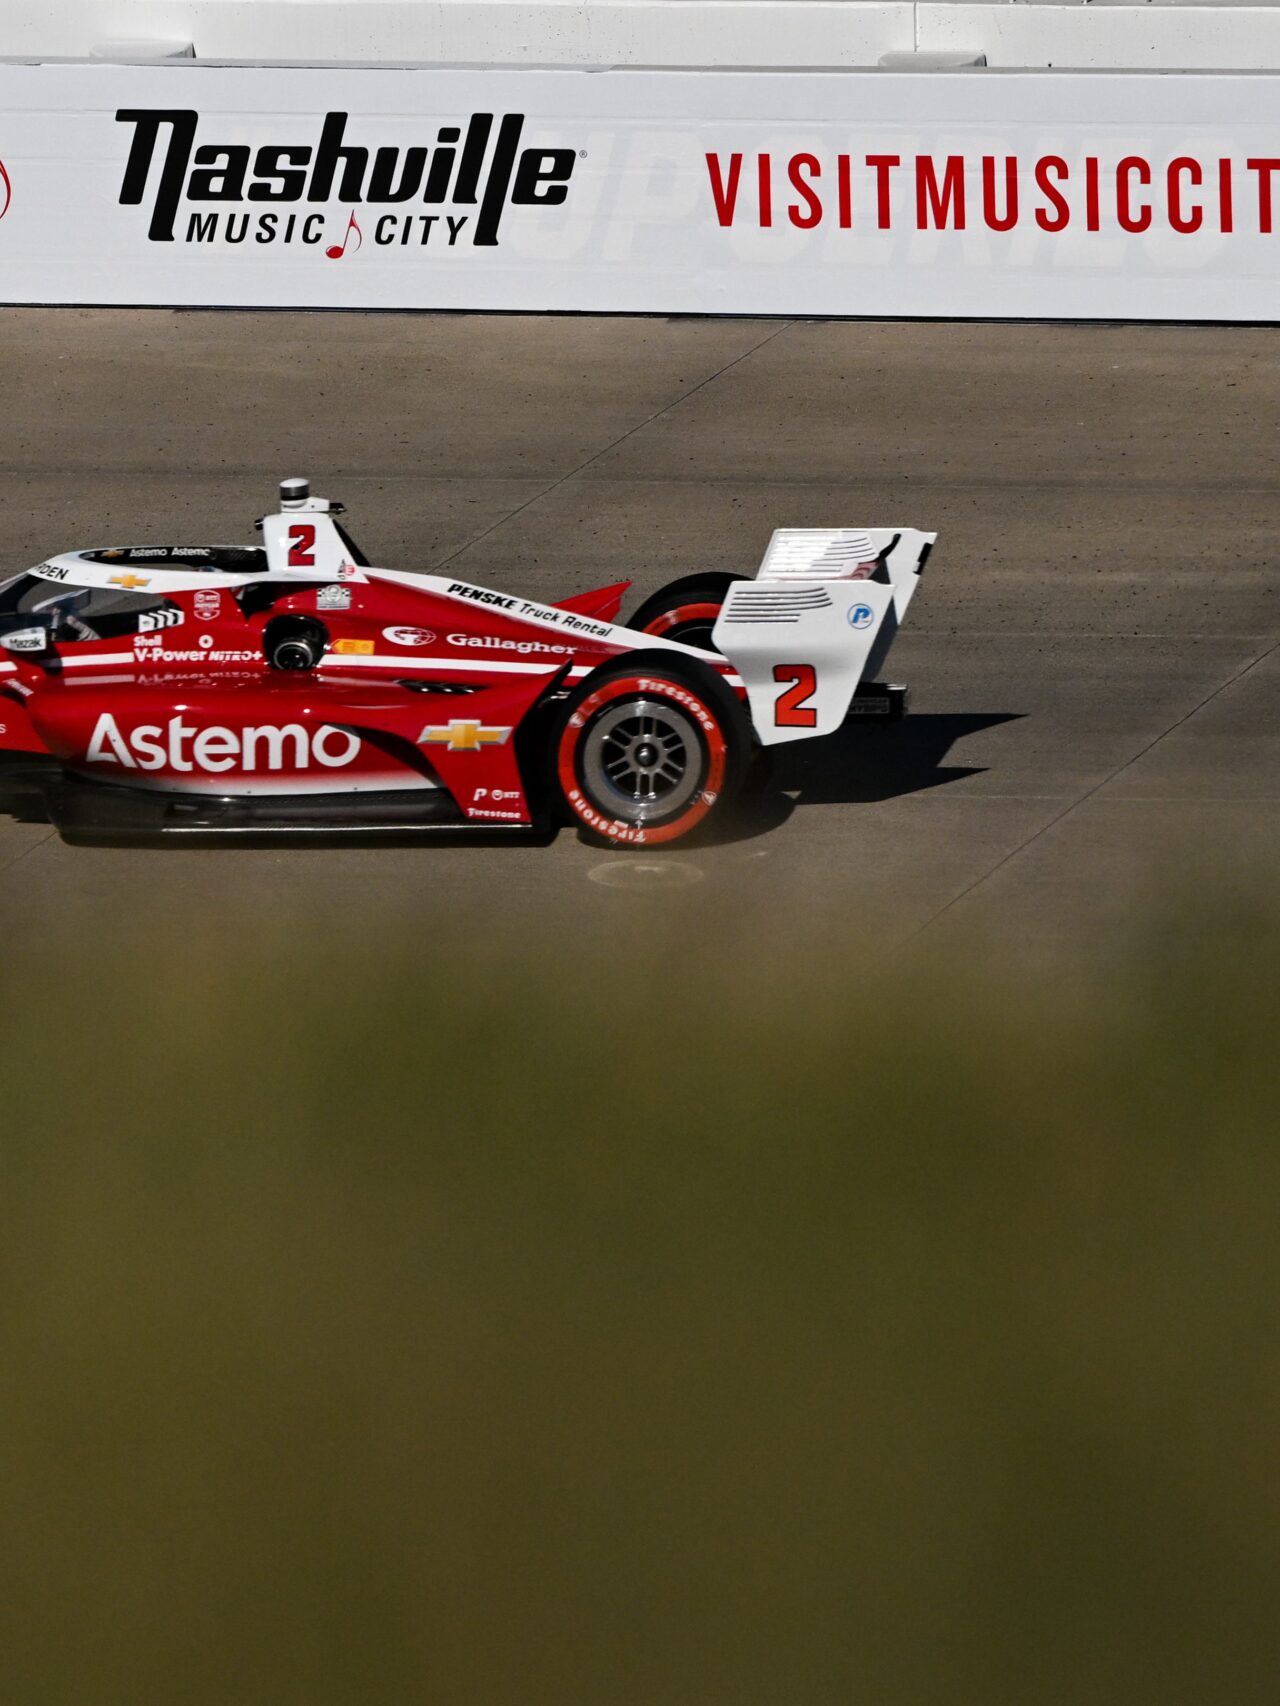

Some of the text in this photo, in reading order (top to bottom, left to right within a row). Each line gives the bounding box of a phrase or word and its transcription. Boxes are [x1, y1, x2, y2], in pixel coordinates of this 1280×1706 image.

[186, 213, 469, 246] MUSIC CITY
[129, 548, 167, 558] Astemo
[288, 524, 316, 567] 2
[447, 584, 613, 637] PENSKE Truck Rental
[133, 634, 162, 646] Shell
[134, 647, 207, 662] V-Power
[446, 633, 577, 655] Gallagher
[637, 679, 714, 731] Firestone
[773, 664, 817, 728] 2
[86, 713, 361, 772] Astemo
[467, 808, 521, 819] Firestone
[569, 790, 645, 843] Firestone
